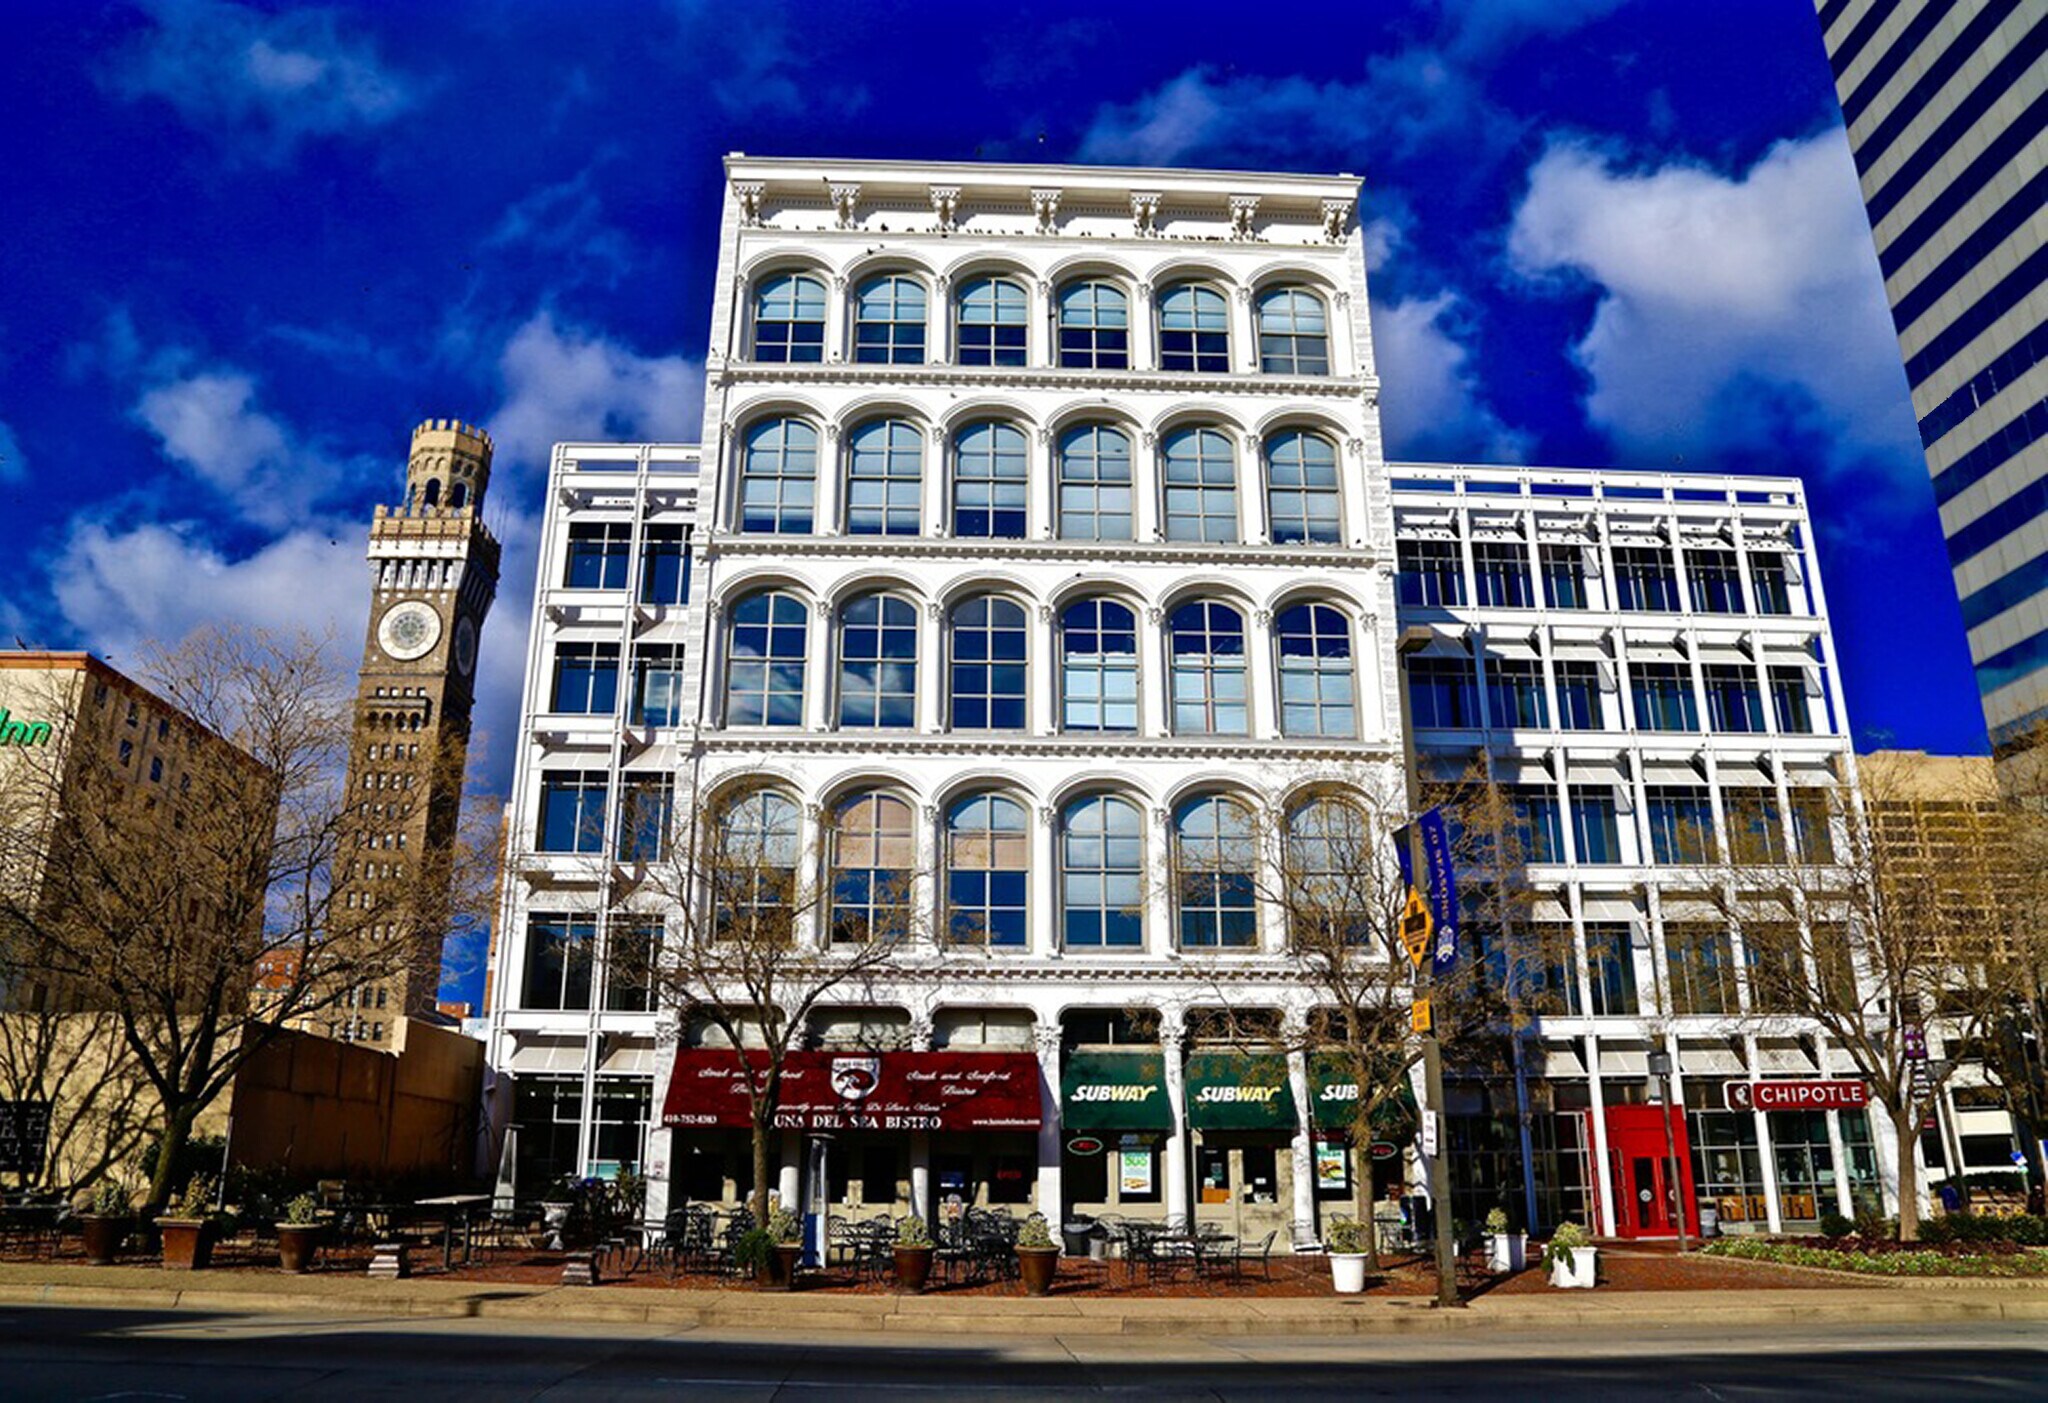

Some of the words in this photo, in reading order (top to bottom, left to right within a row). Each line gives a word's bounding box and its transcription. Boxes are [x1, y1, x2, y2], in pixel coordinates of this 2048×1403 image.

[1434, 849, 1448, 919] SEASONS
[1070, 1085, 1158, 1101] SUBWAY
[1196, 1086, 1281, 1102] SUBWAY
[1760, 1086, 1863, 1102] CHIPOTLE
[770, 1114, 805, 1129] UNA
[812, 1115, 844, 1129] DEL
[850, 1115, 879, 1129] SEA
[885, 1115, 942, 1130] BISTRO
